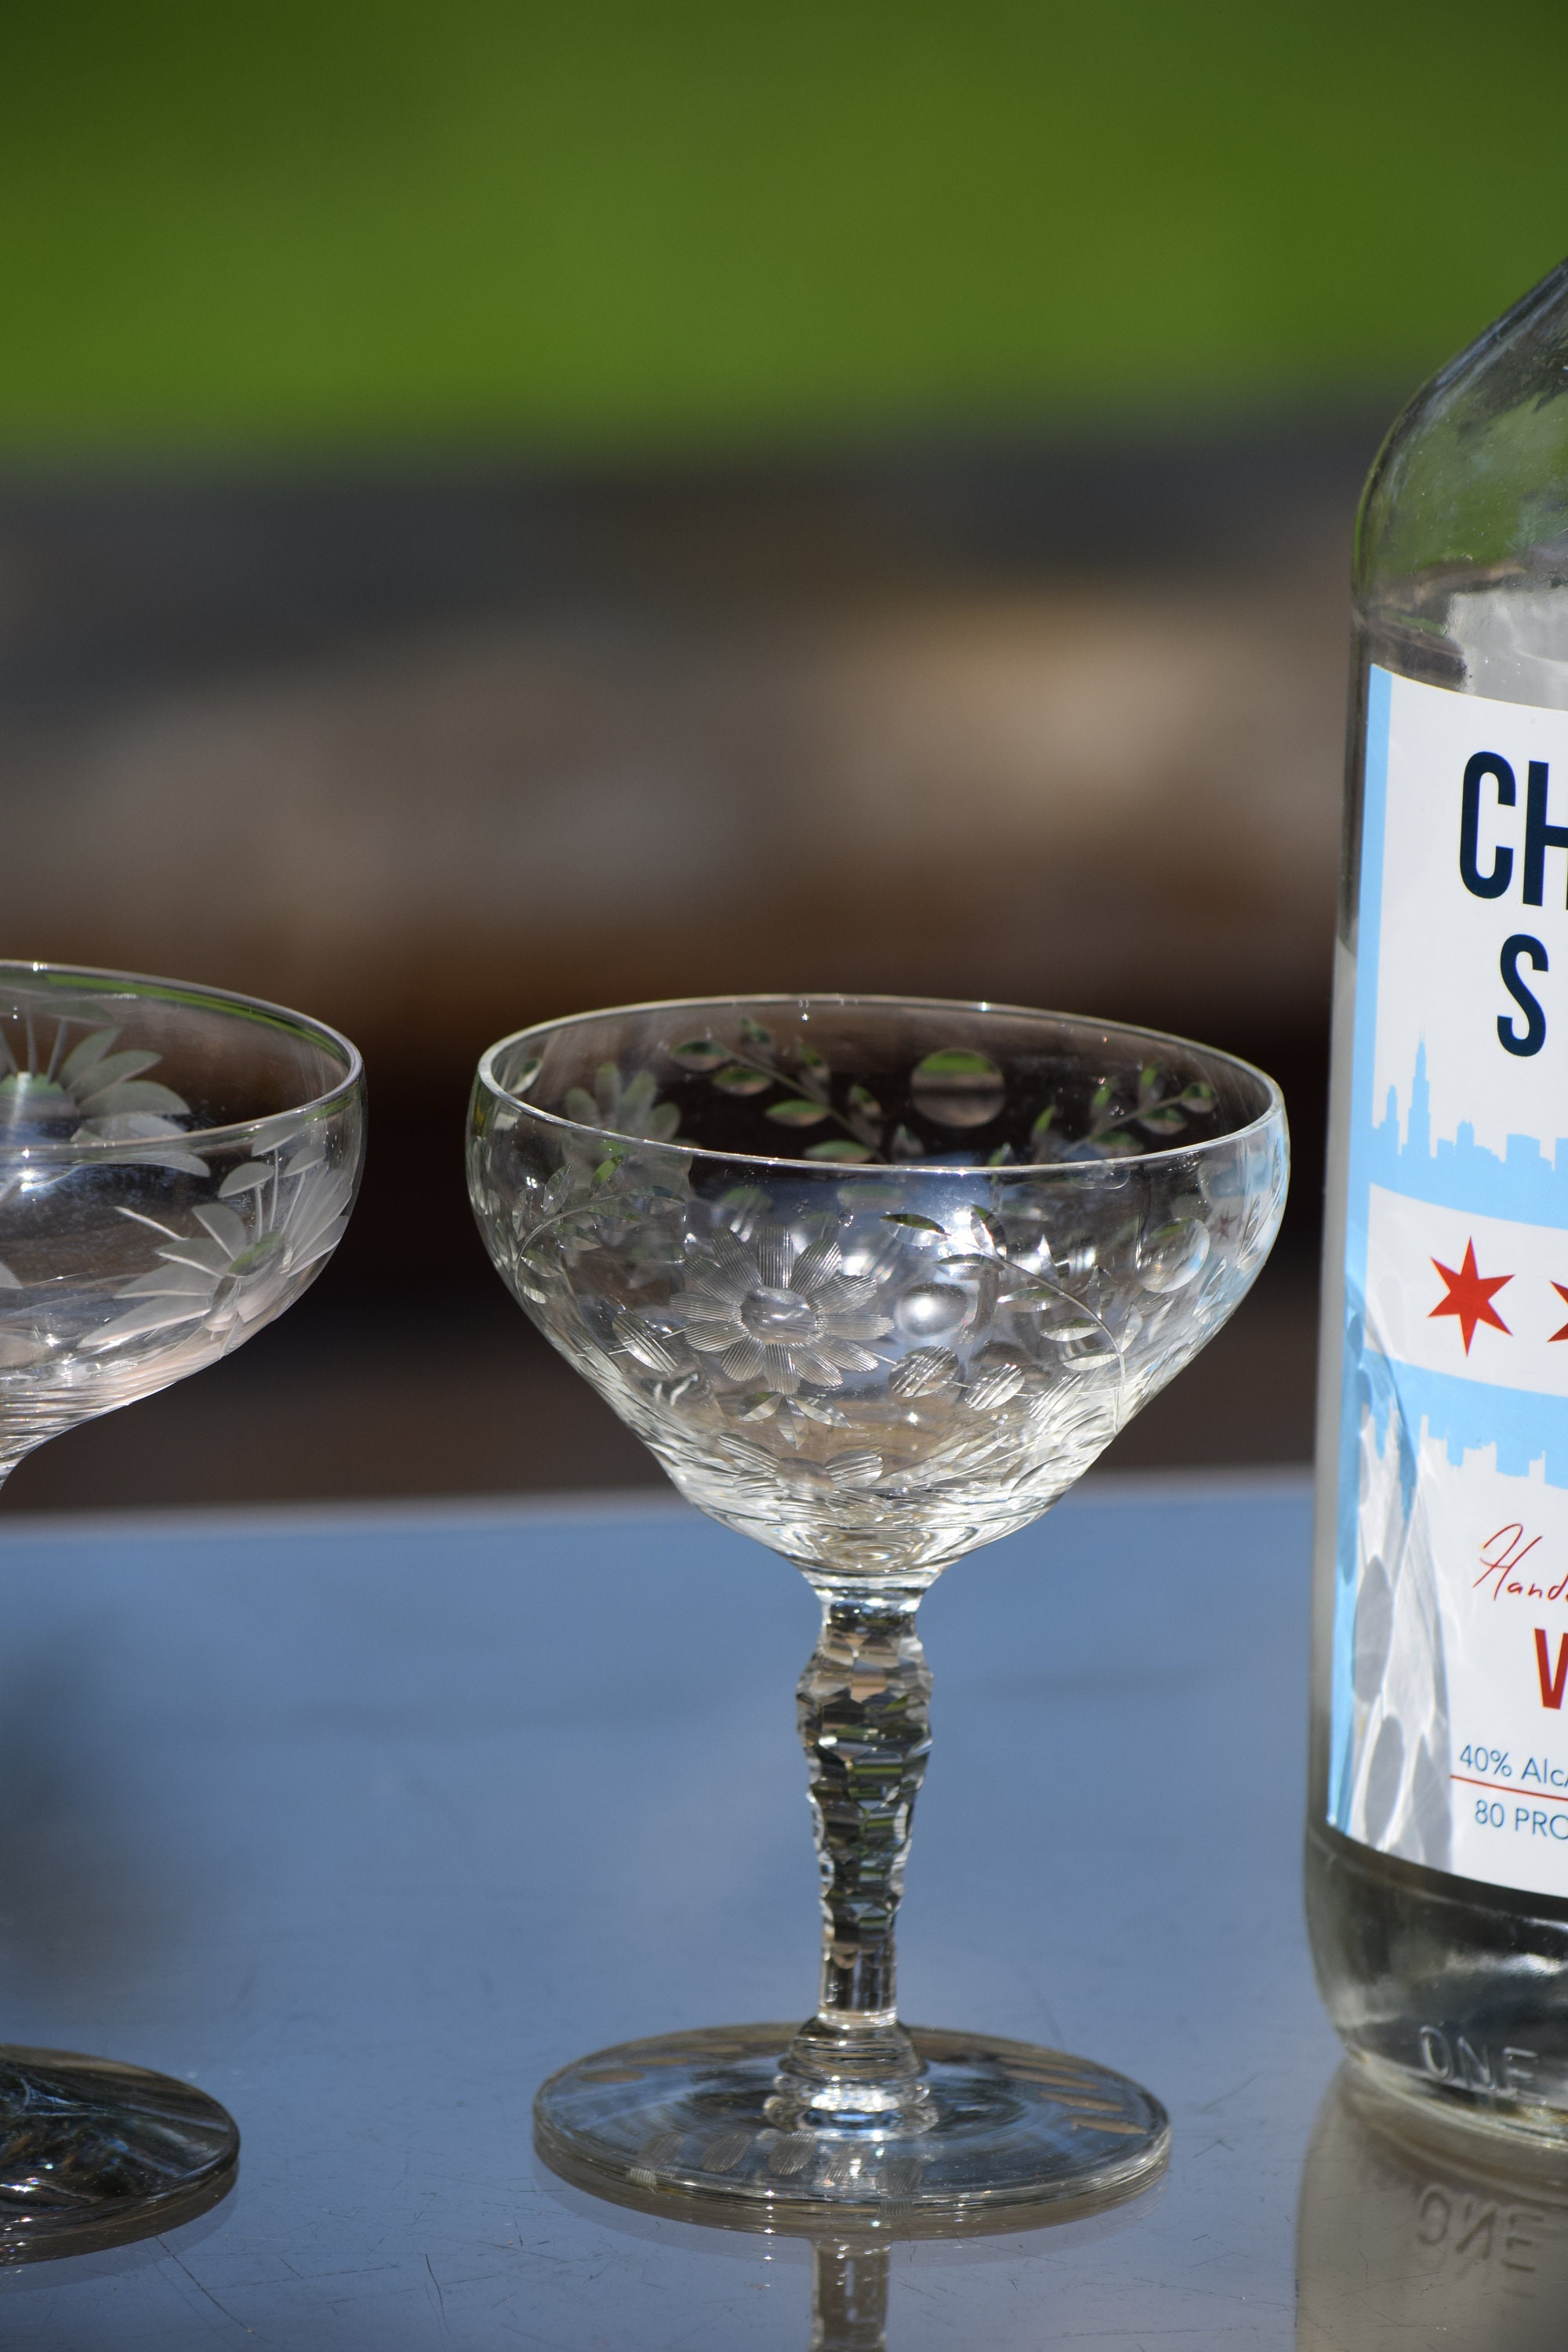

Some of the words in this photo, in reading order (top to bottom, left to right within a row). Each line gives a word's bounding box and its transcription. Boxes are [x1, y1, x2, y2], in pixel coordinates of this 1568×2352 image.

[1460, 751, 1568, 910] CH
[1497, 934, 1548, 1057] S
[1472, 1523, 1568, 1602] Hand
[1534, 1628, 1568, 1710] V
[1460, 1744, 1512, 1777] 40%
[1475, 1799, 1504, 1828] 80
[1419, 2026, 1544, 2103] ONE
